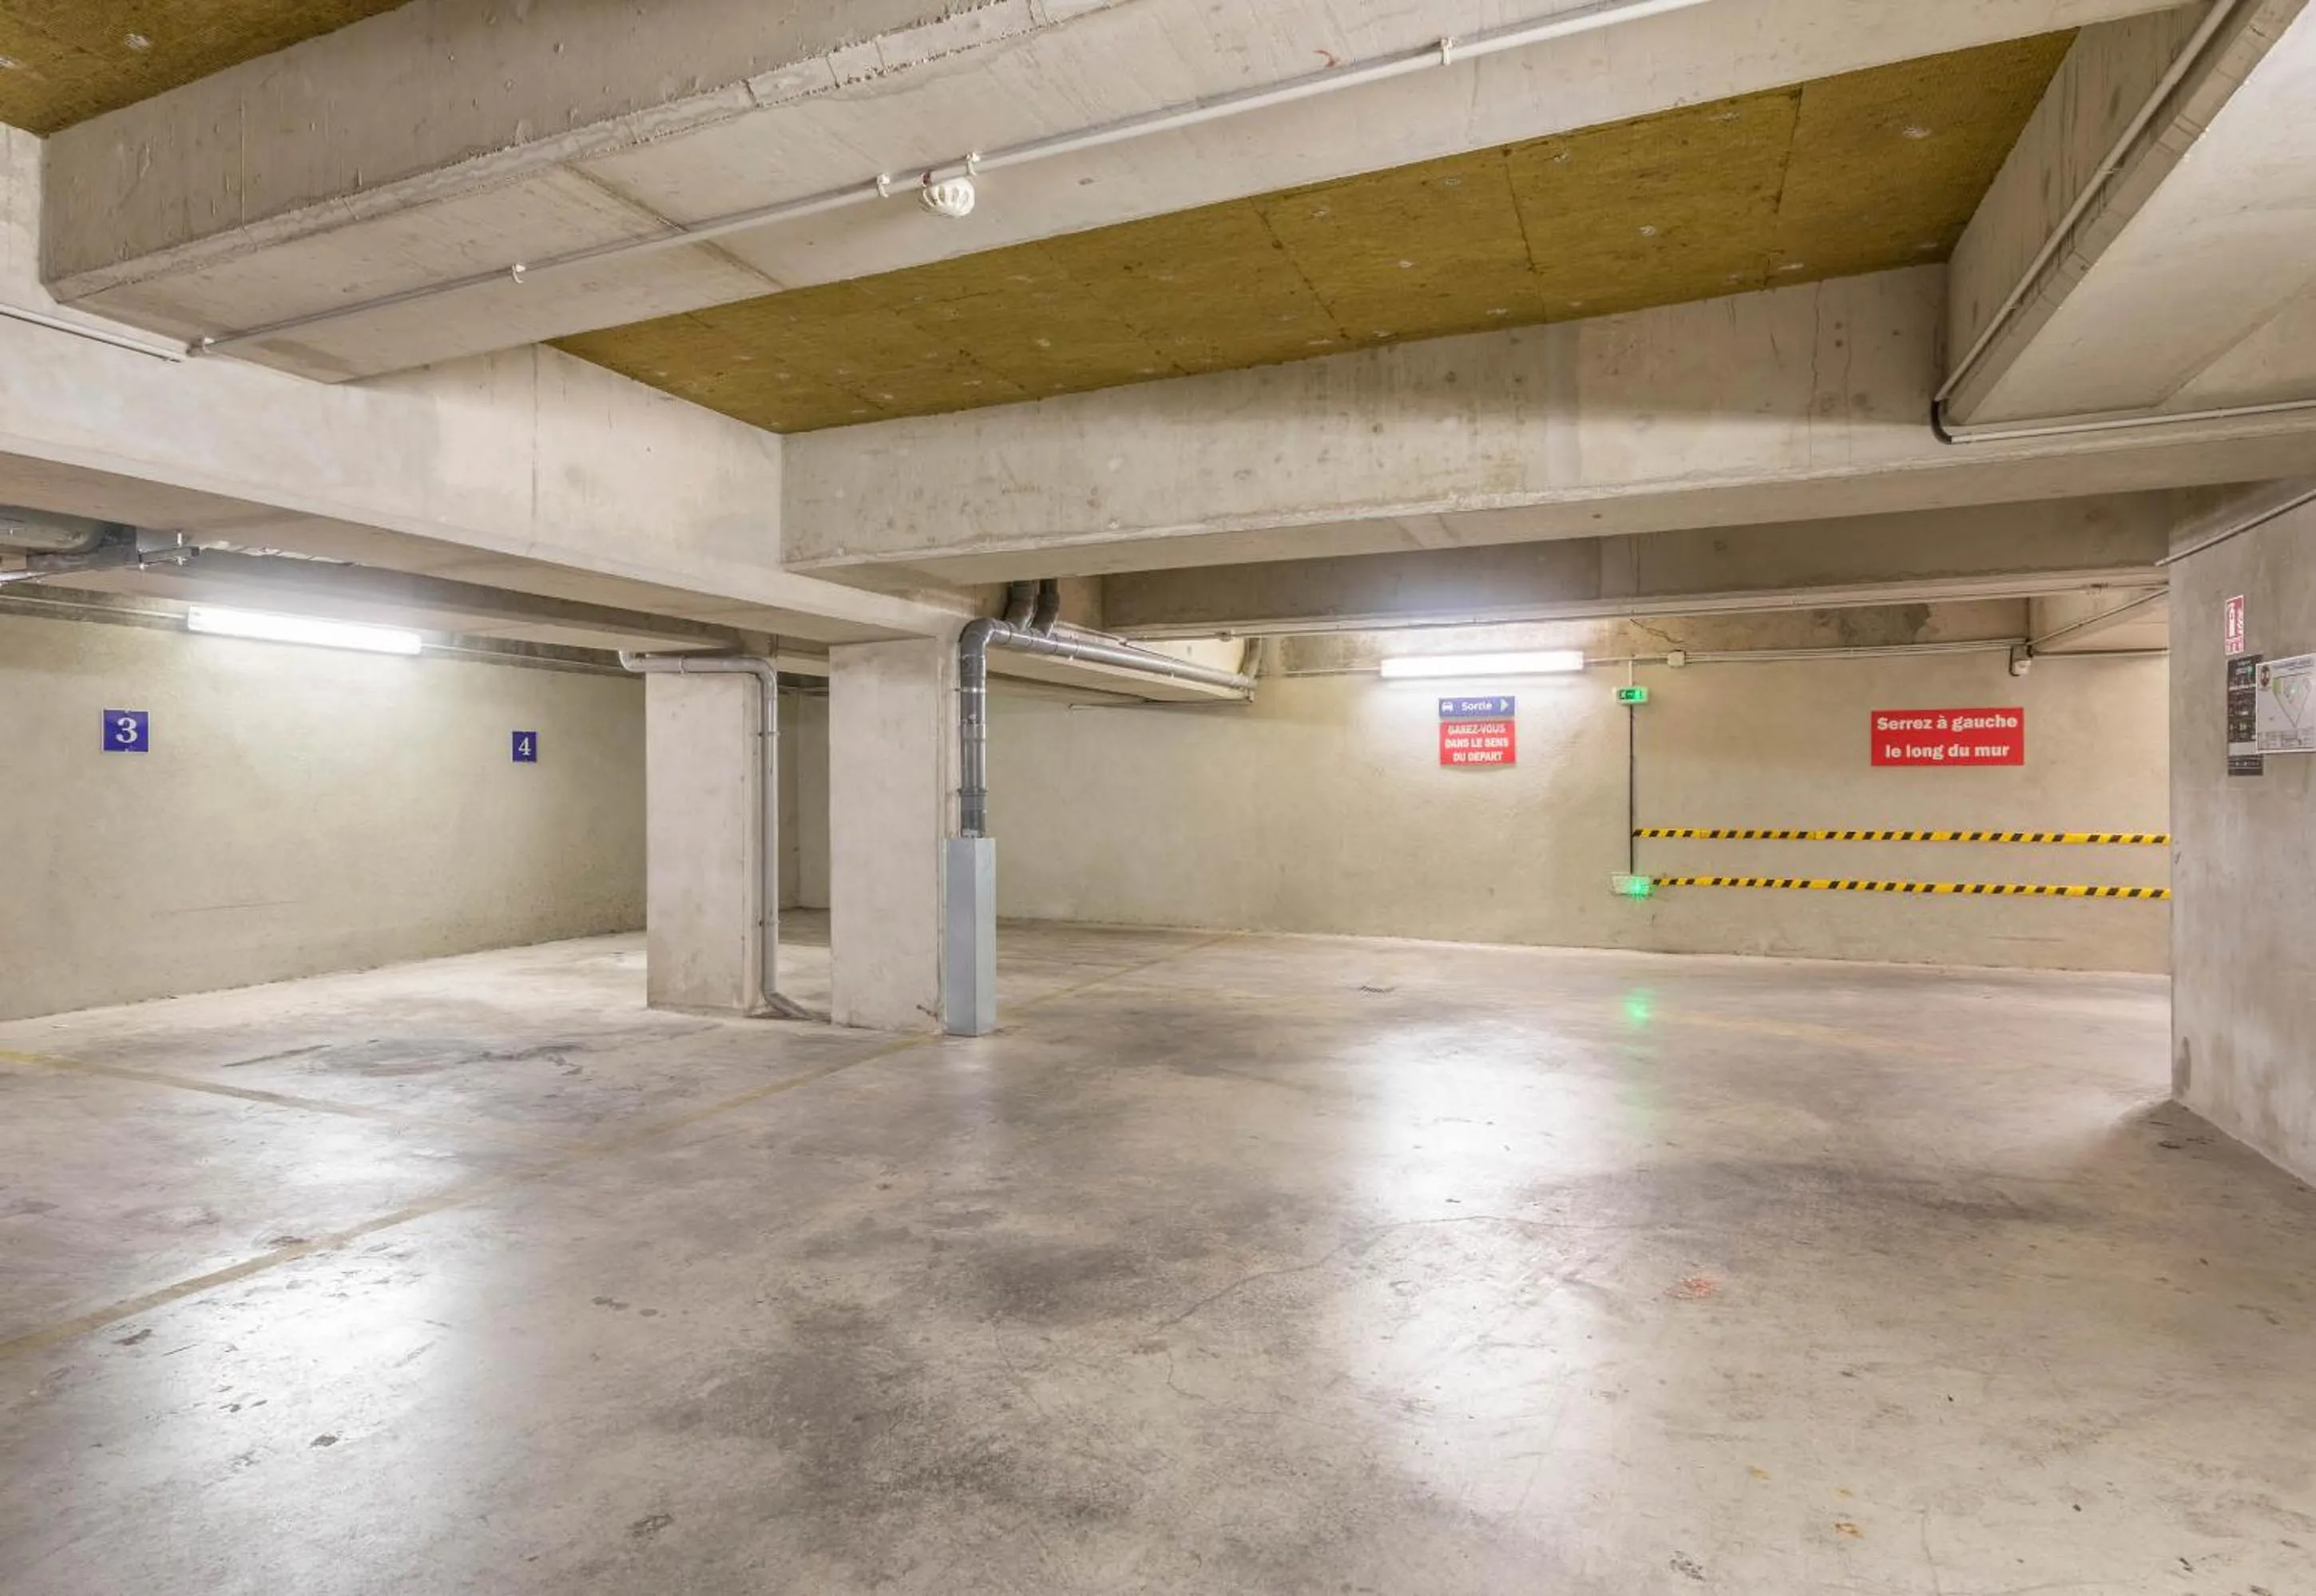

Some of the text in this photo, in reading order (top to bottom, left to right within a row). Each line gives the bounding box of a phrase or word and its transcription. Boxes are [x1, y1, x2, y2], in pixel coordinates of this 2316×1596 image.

[1461, 700, 1493, 711] Sortie
[115, 717, 138, 743] 3
[1877, 715, 2018, 732] Serrez à gauche
[518, 737, 532, 755] 4
[1444, 737, 1509, 749] DANS LE SENS
[1885, 743, 2010, 760] le long du mur
[1453, 751, 1467, 762] DU
